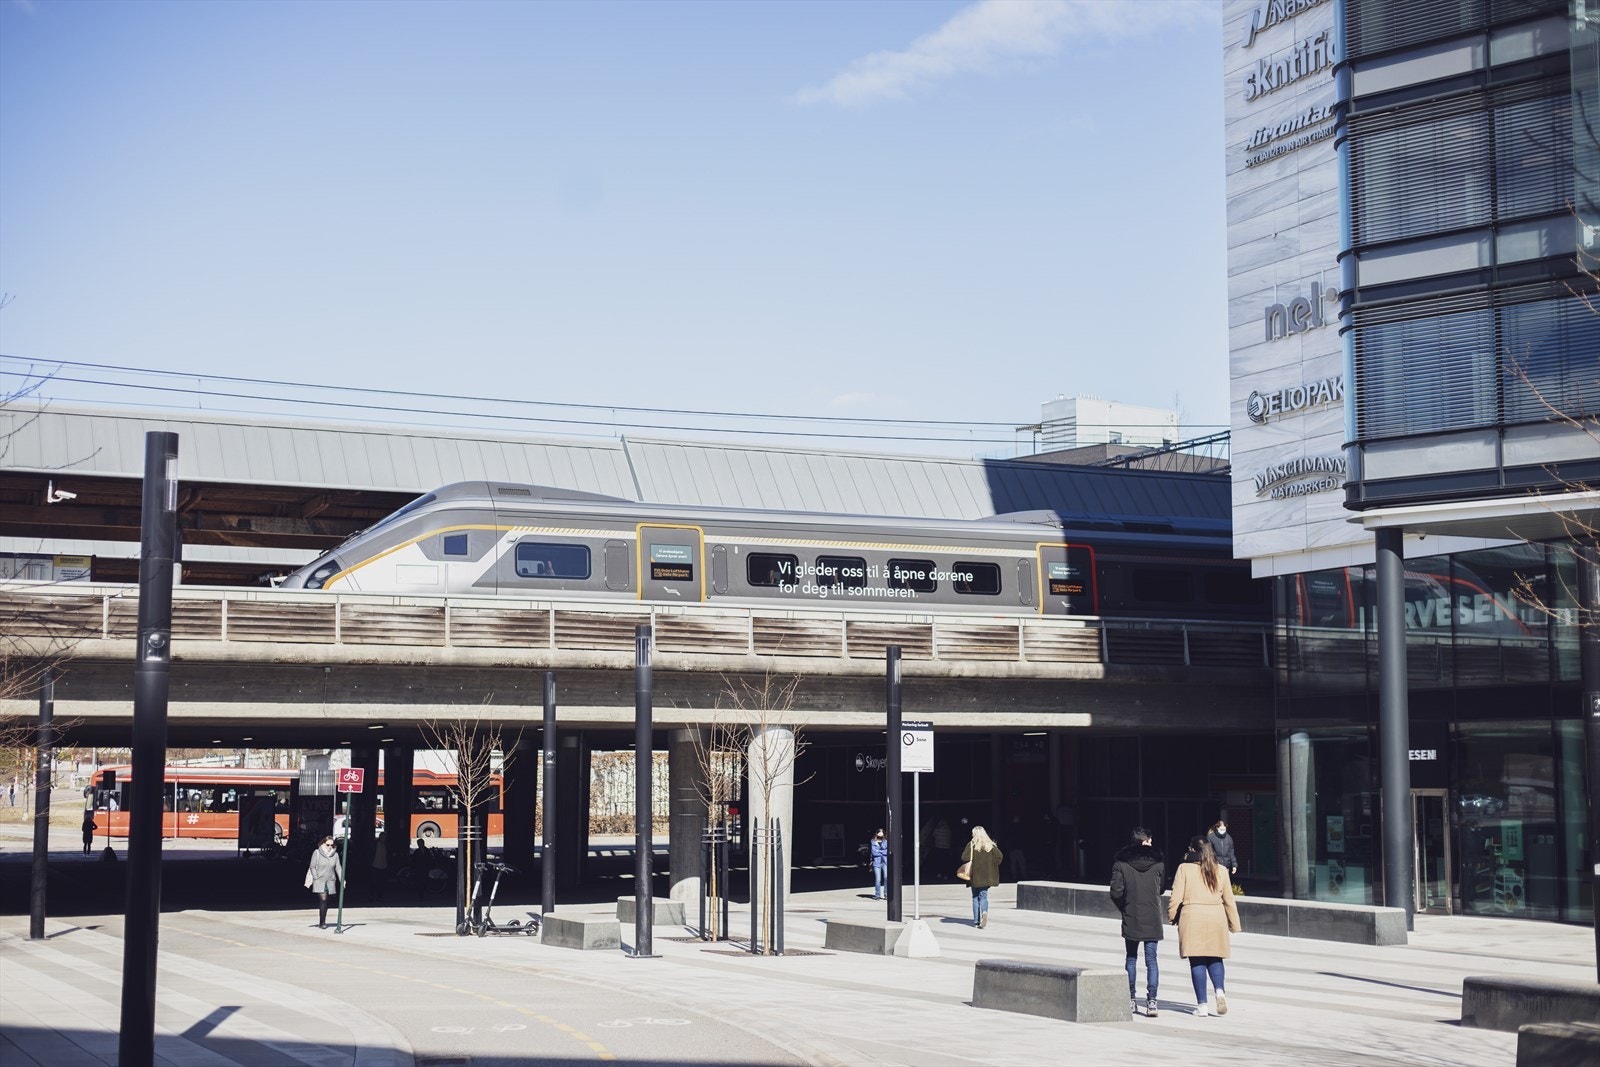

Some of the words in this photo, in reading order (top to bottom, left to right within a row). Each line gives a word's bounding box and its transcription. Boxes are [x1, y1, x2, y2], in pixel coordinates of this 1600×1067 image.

[1244, 144, 1287, 168] SPECIALIZED
[1296, 134, 1309, 150] AIR
[1265, 281, 1320, 341] nel
[1267, 376, 1344, 415] ELOPAK
[1253, 457, 1346, 492] MASCHMANN
[1270, 477, 1337, 500] MATMARKED
[778, 561, 791, 575] Vi
[795, 562, 838, 578] gleder
[841, 567, 864, 577] oss
[866, 565, 878, 577] til
[883, 565, 890, 579] å
[894, 565, 926, 584] åpne
[929, 567, 974, 582] dørene
[779, 580, 799, 593] for
[802, 581, 828, 598] deg
[831, 582, 844, 596] til
[848, 585, 920, 598] sommeren.
